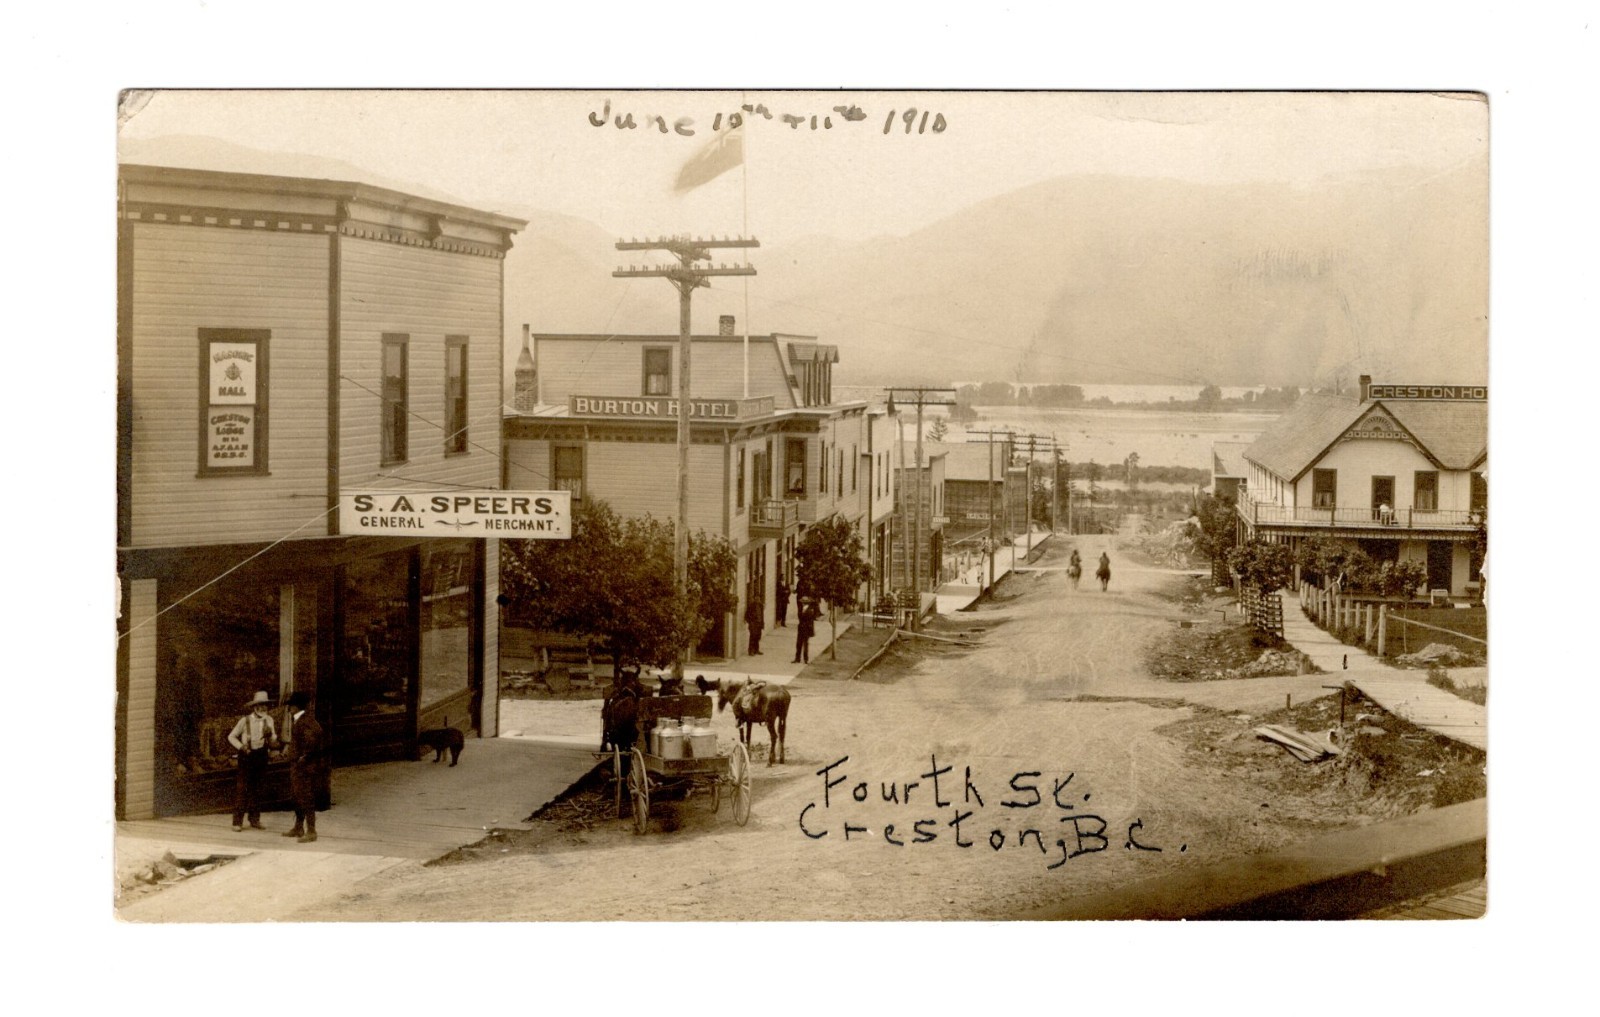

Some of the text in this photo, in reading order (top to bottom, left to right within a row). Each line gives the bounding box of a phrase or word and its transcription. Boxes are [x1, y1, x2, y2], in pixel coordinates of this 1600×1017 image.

[588, 99, 695, 137] June
[883, 107, 947, 135] 1910
[1371, 386, 1487, 399] CRESTON HO
[576, 398, 659, 416] BURTON
[360, 516, 560, 531] GENERAL MERCHANT.
[816, 753, 984, 808] Fourth
